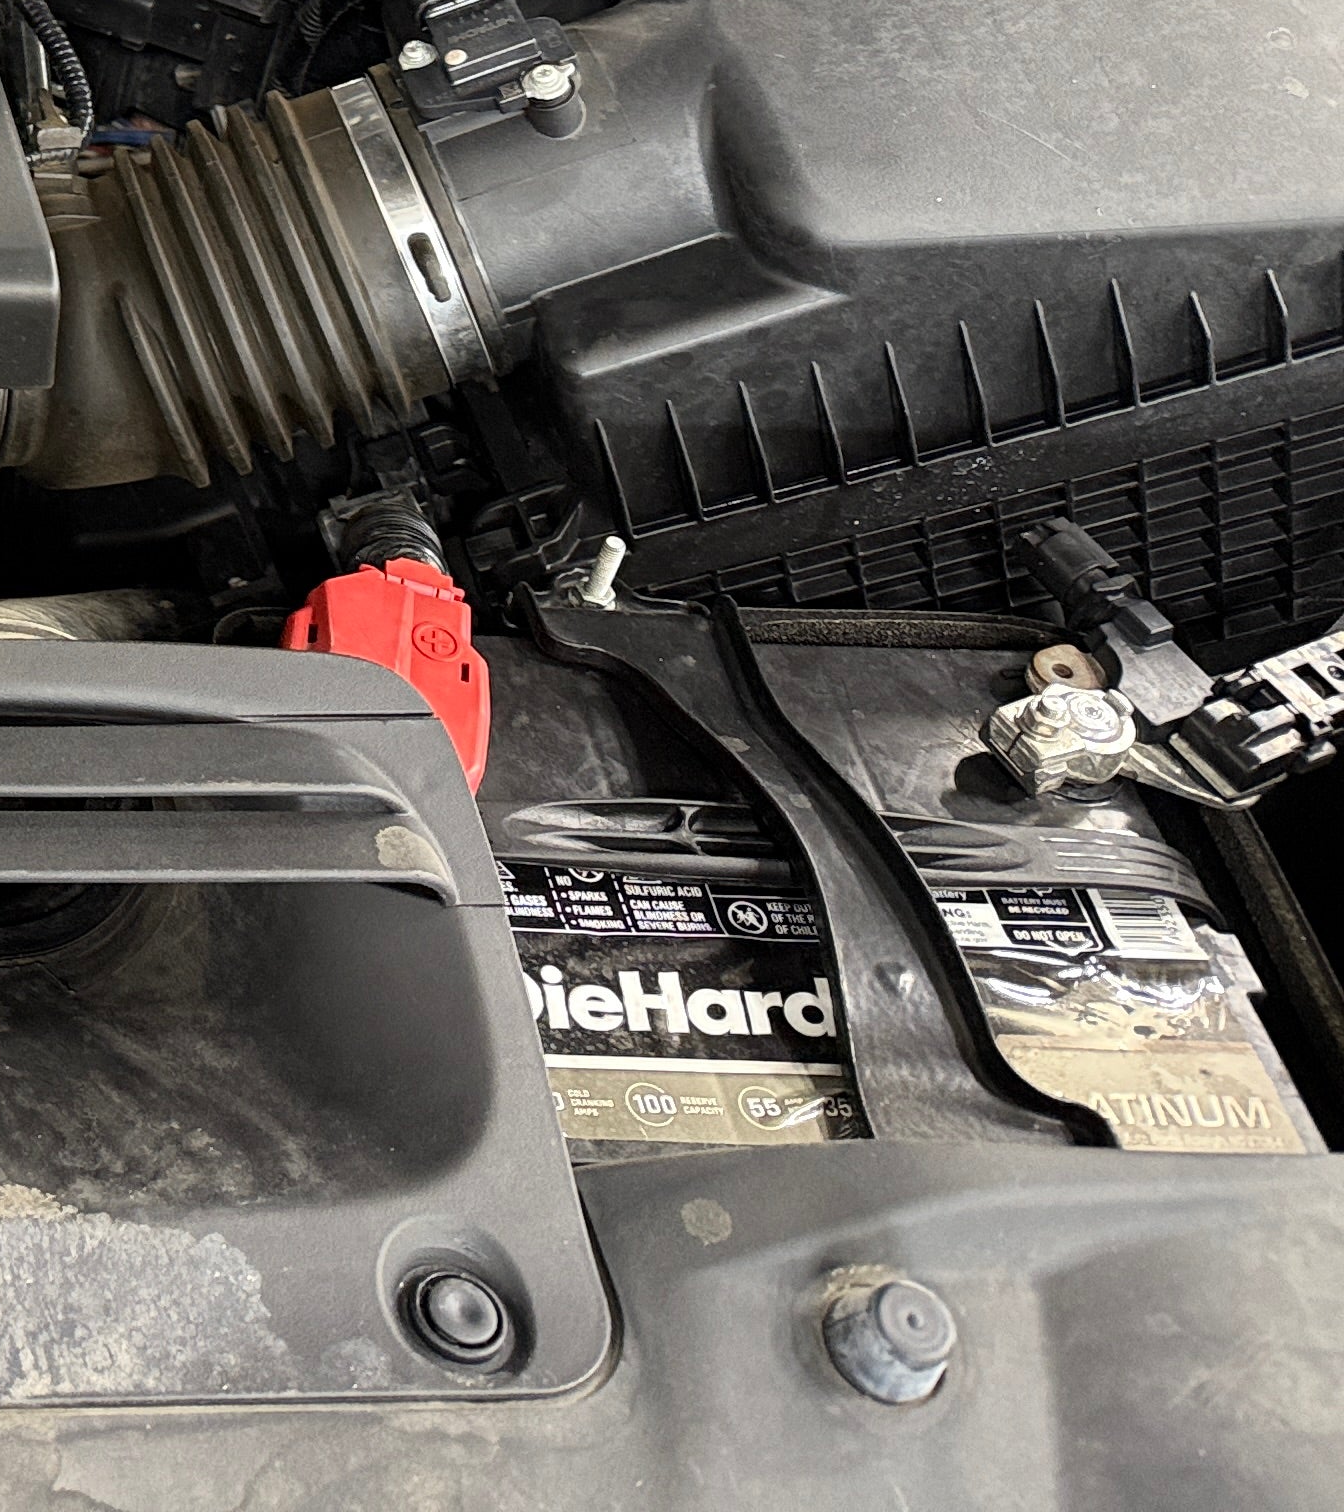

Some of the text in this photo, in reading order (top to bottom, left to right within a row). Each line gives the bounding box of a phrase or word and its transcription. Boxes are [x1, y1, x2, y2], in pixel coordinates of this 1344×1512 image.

[554, 875, 572, 887] NO
[567, 890, 609, 902] SPARKS
[623, 883, 703, 899] SULFURIC ACID
[510, 894, 548, 907] GASES
[629, 899, 687, 912] CAN CAUSE
[1001, 897, 1067, 907] BATTERY MUST
[571, 904, 614, 917] FLAMES
[765, 902, 791, 912] KEEP
[1007, 906, 1070, 916] BE RECYCLED
[632, 910, 706, 923] BLINDNESS OR
[770, 913, 784, 923] OF
[785, 913, 806, 924] THE
[577, 918, 626, 931] SMOKING
[636, 920, 677, 931] SEVERE
[774, 924, 789, 935] OF
[1012, 929, 1031, 941] DO
[1030, 930, 1055, 942] NOT
[566, 1088, 591, 1099] COLD
[569, 1097, 615, 1109] CRANKING
[632, 1093, 678, 1115] 100
[679, 1095, 719, 1107] RESERVE
[573, 1106, 600, 1118] AMPS
[682, 1105, 724, 1117] CAPACITY
[745, 1097, 782, 1118] 55
